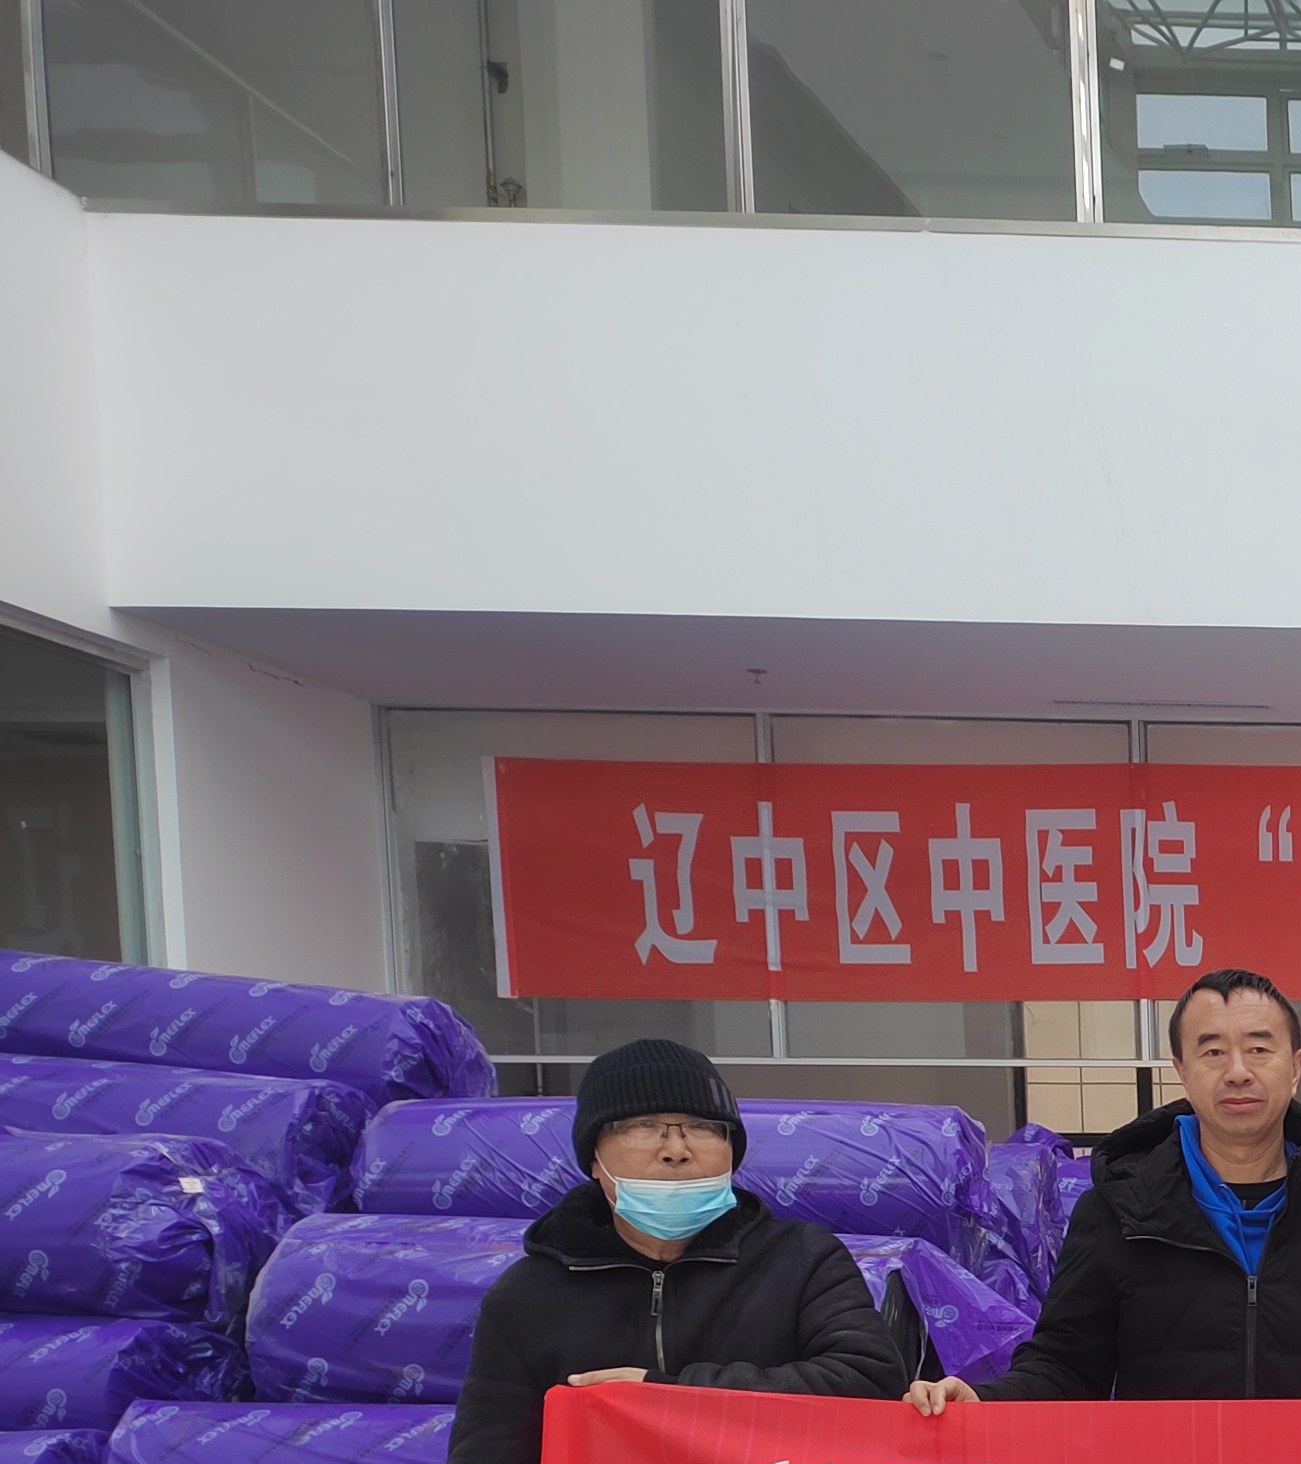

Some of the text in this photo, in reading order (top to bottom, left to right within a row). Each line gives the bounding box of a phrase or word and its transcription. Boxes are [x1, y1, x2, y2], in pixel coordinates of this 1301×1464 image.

[629, 801, 1203, 973] 辽中区中医院
